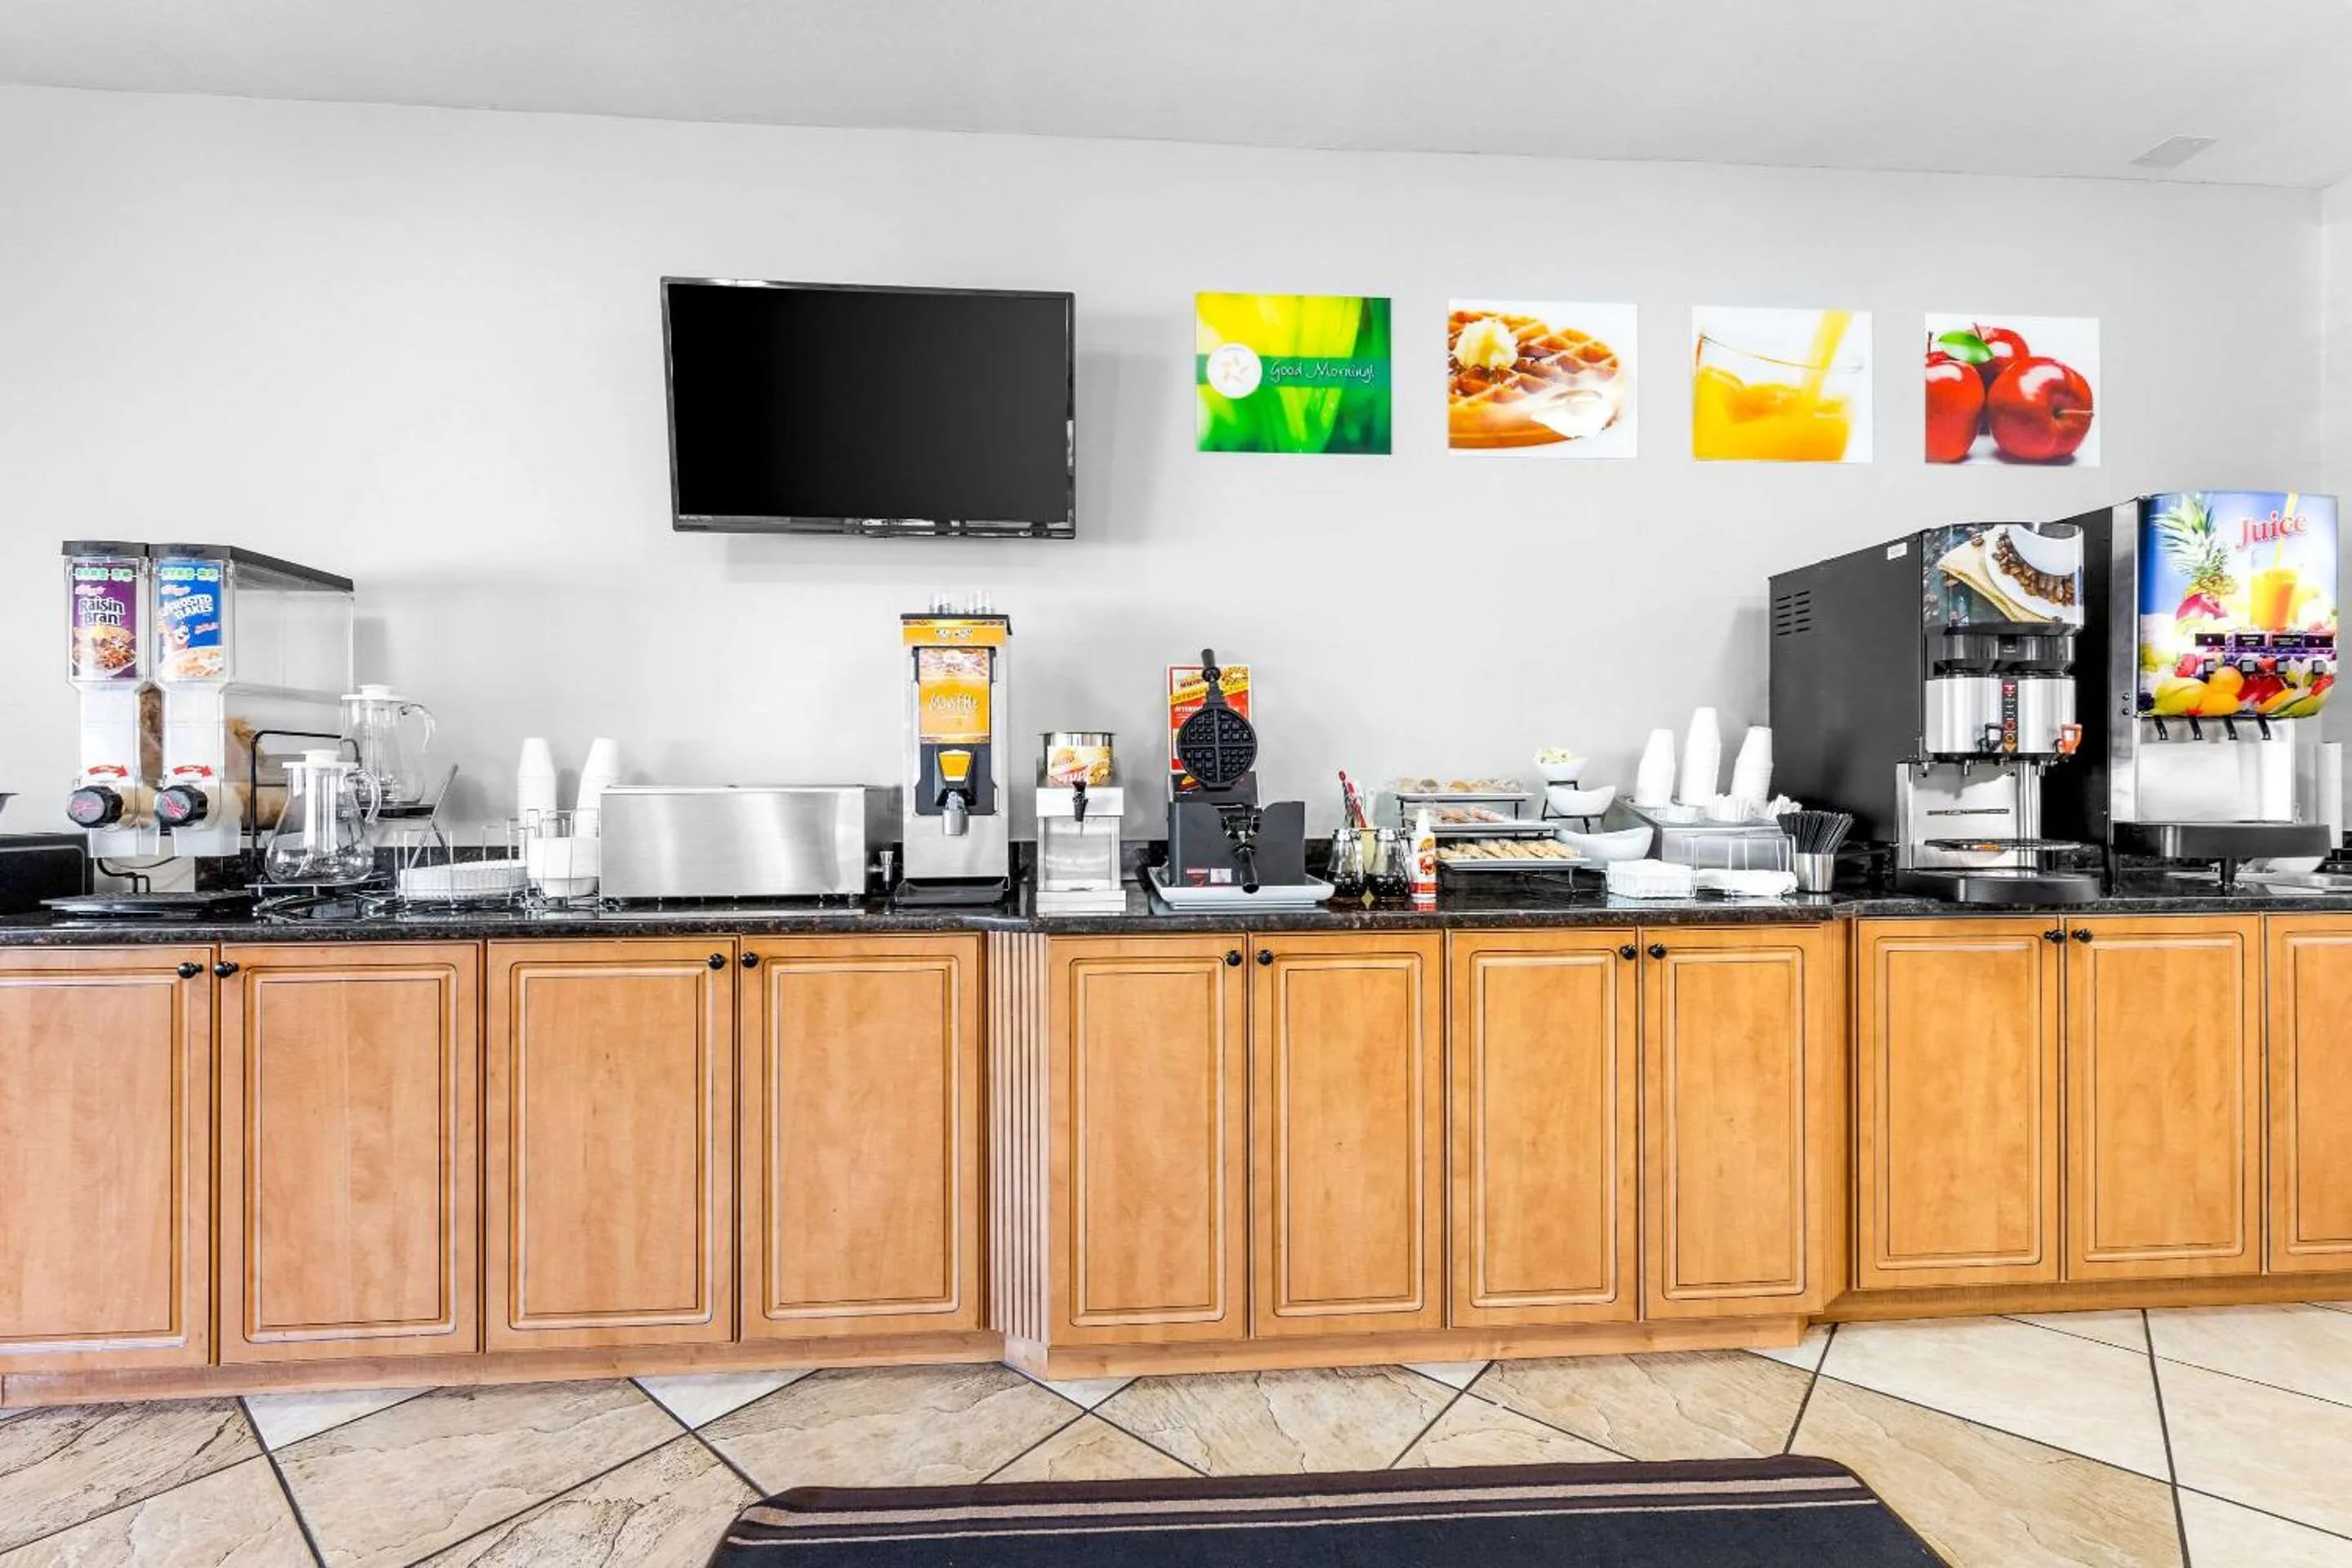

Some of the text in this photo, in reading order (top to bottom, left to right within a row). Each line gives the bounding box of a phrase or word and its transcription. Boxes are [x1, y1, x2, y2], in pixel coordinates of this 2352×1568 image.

[1270, 359, 1374, 383] Good Morning!
[2235, 511, 2307, 550] Juice
[79, 596, 124, 614] Raisin
[84, 612, 118, 625] Bran
